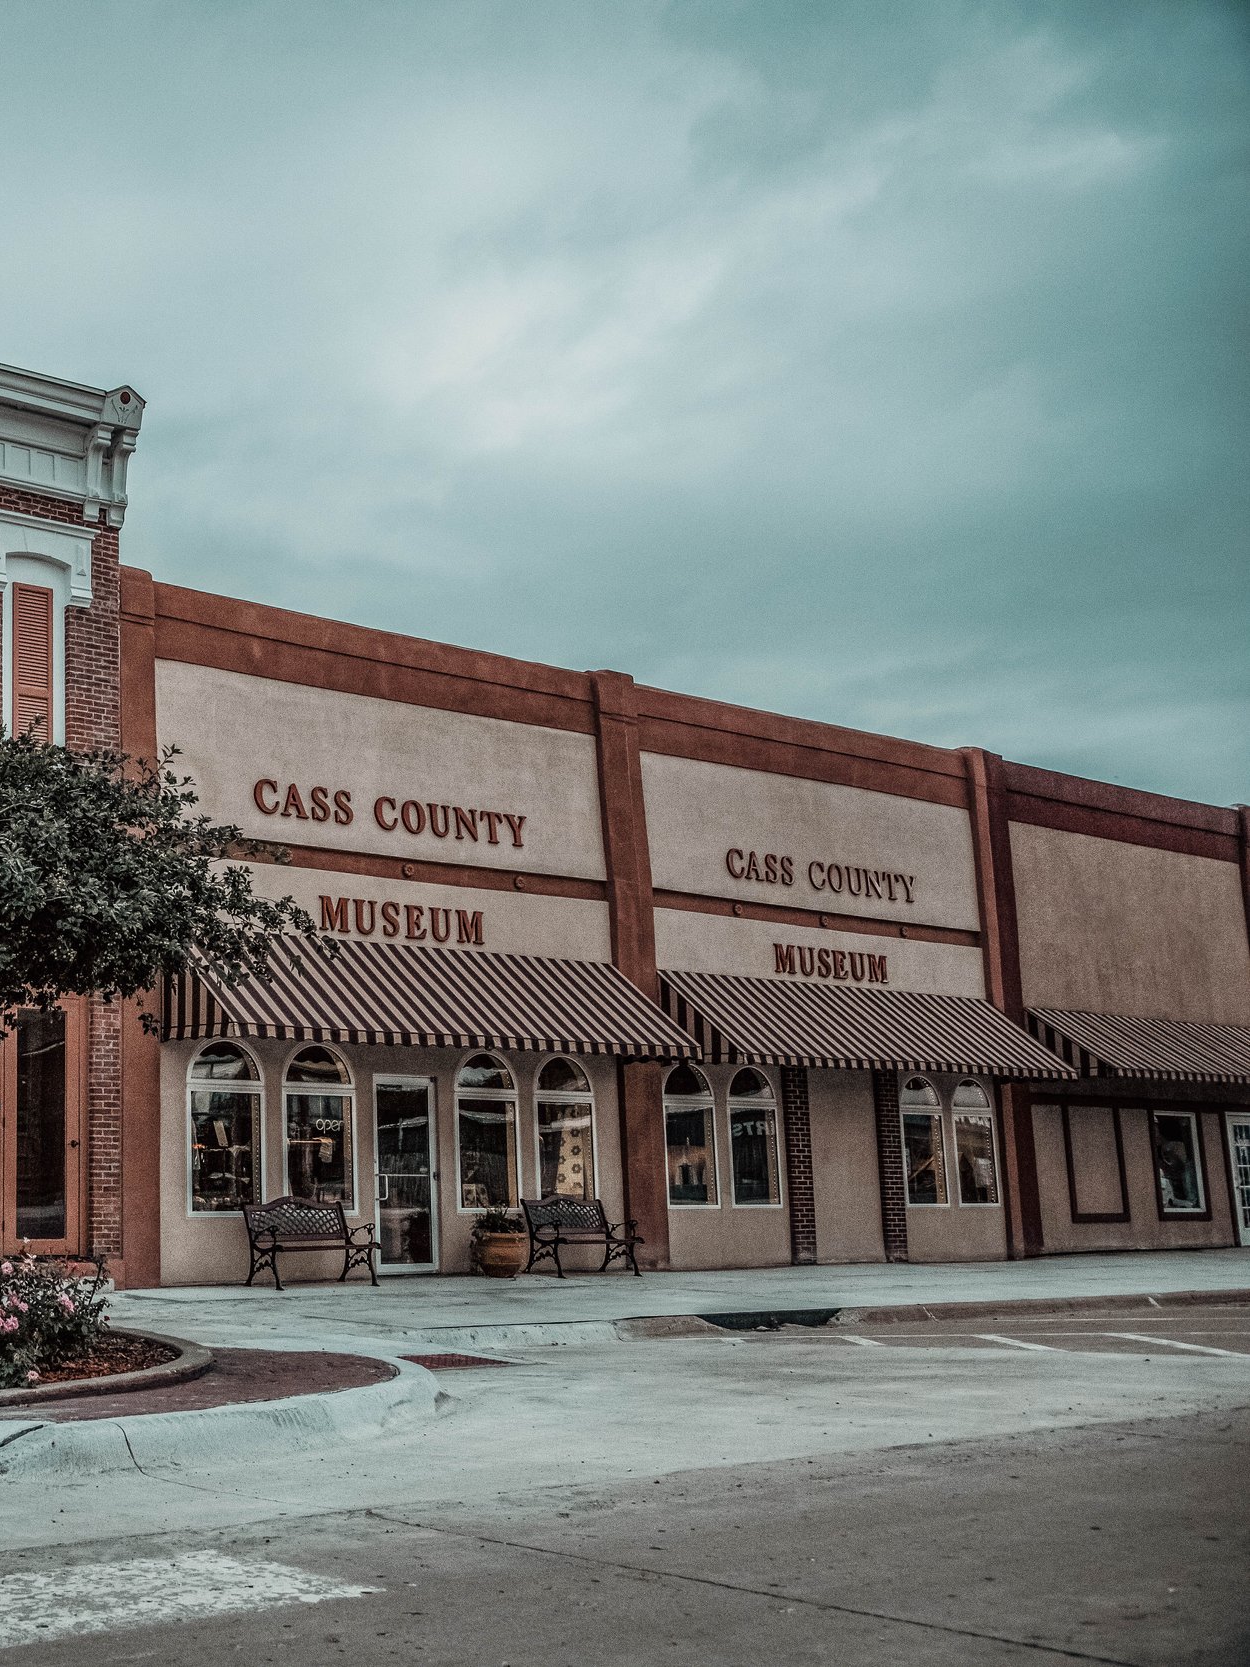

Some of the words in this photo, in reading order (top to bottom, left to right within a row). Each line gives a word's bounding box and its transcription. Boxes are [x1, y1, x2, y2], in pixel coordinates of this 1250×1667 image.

[254, 778, 353, 825] CASS
[375, 797, 527, 847] COUNTY
[727, 849, 794, 886] CASS
[809, 862, 915, 902] COUNTY
[319, 895, 485, 945] MUSEUM
[774, 944, 888, 983] MUSEUM
